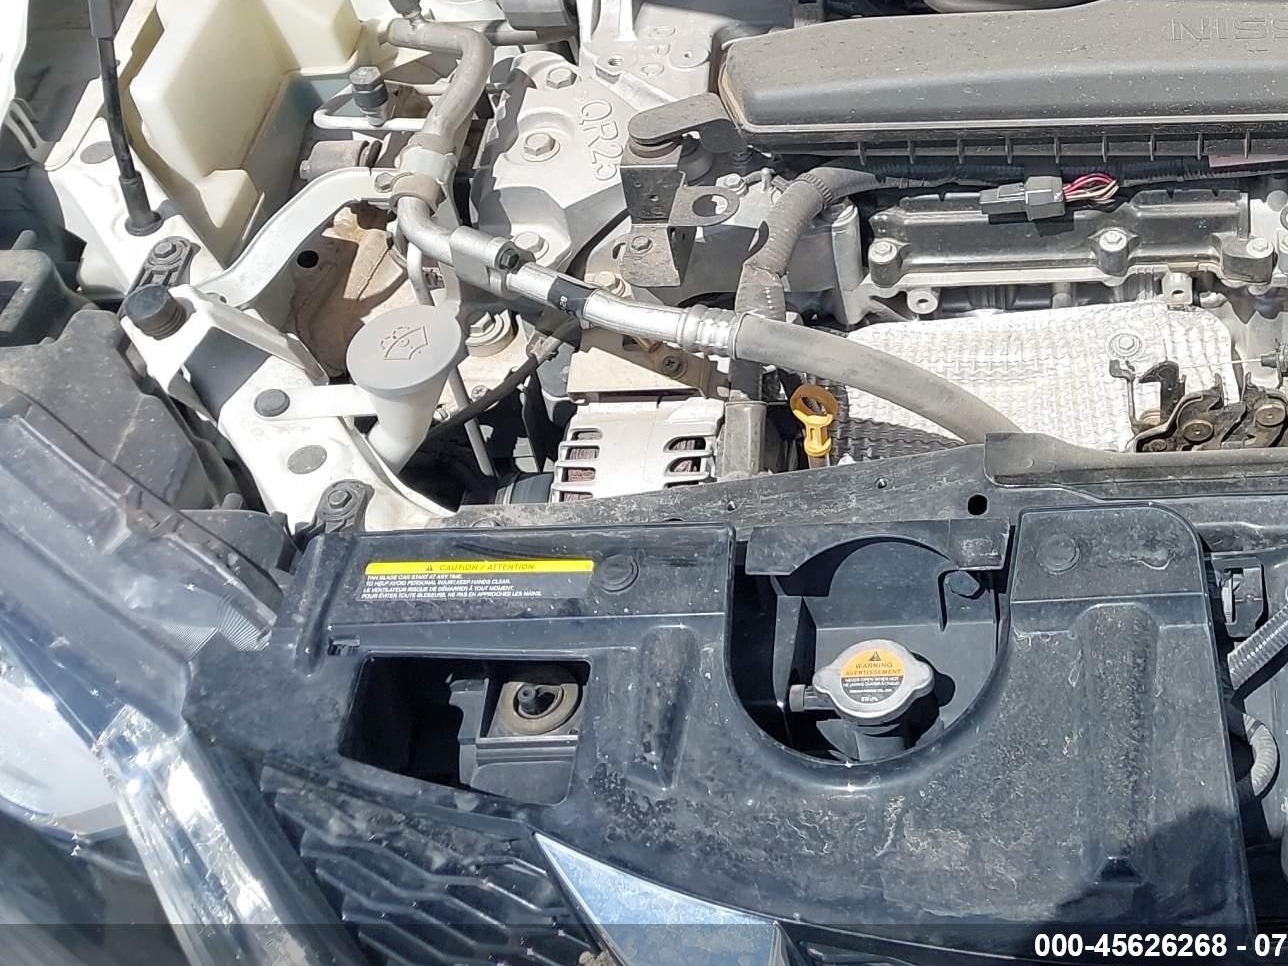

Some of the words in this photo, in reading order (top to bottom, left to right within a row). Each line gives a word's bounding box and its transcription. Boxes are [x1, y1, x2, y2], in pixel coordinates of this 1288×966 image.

[579, 99, 624, 182] QR25
[439, 563, 479, 571] CAUTION
[487, 563, 535, 571] ATTENTION
